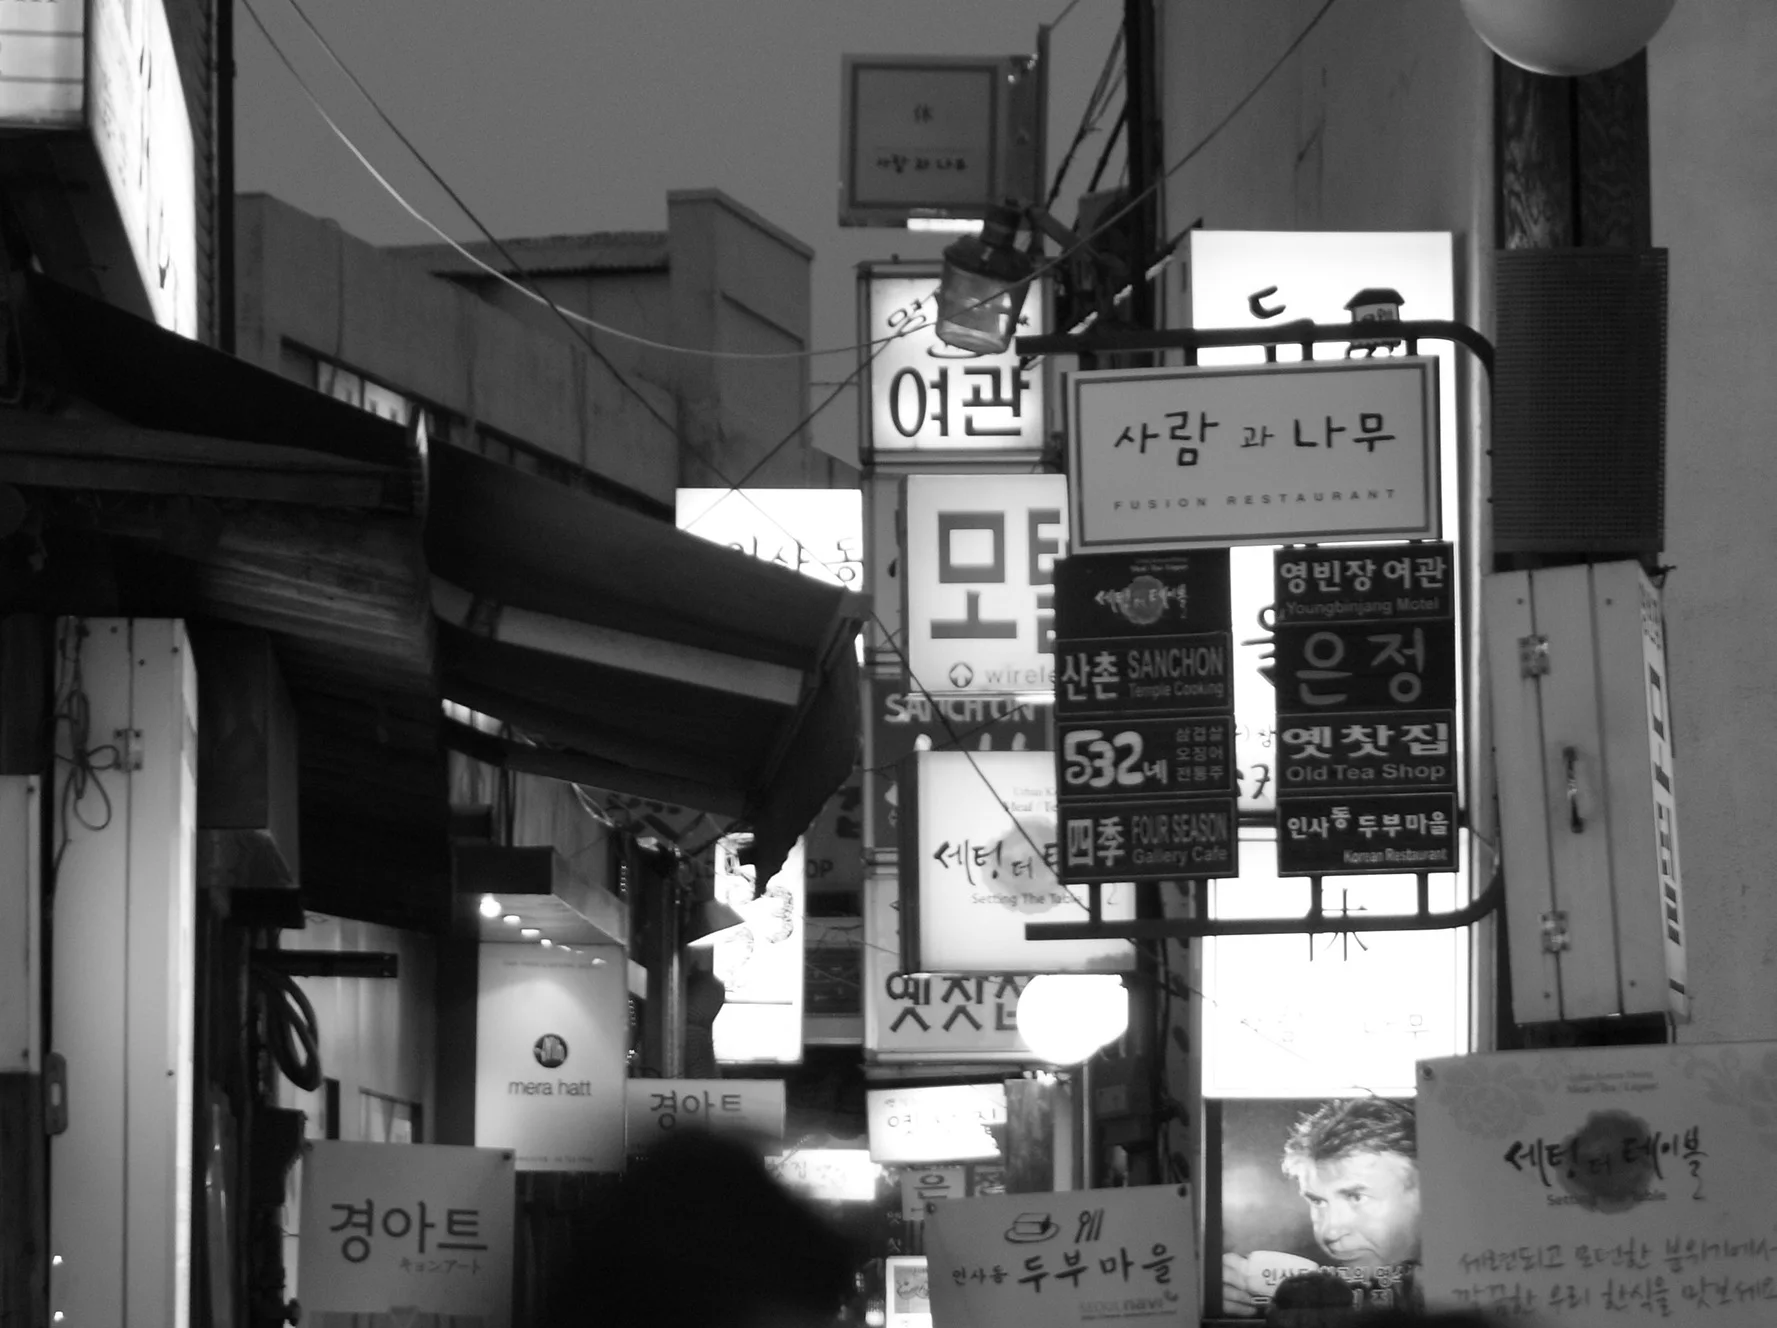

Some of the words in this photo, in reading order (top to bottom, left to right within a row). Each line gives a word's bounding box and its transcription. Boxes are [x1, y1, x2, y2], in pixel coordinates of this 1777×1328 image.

[889, 366, 1030, 437] 여관
[1114, 411, 1220, 466] 사람
[1241, 425, 1274, 448] 과
[1294, 412, 1396, 452] 나무
[1113, 498, 1207, 511] FUSION
[1226, 488, 1396, 506] RESTAURANT
[1280, 559, 1377, 593] 영빈장
[1383, 556, 1447, 590] 여관
[1397, 597, 1440, 611] Motel
[1061, 651, 1120, 701] 산촌
[1127, 646, 1225, 679] SANCHON
[1296, 627, 1426, 705] 은정
[1064, 730, 1168, 787] 532네
[1281, 722, 1449, 759] 옛찻집
[1286, 765, 1328, 781] Old
[1333, 765, 1375, 780] Tea
[1382, 763, 1446, 781] Shop
[1067, 816, 1126, 866] 四季
[1131, 814, 1170, 844] FOUR
[1172, 812, 1228, 842] SEASON
[1287, 806, 1351, 840] 인사동
[1358, 811, 1449, 839] 두부마을
[508, 1080, 553, 1096] mera
[557, 1078, 592, 1096] hatt
[650, 1090, 742, 1130] 경아트
[329, 1198, 489, 1263] 경아트
[1018, 1244, 1176, 1293] 두부마을
[1548, 1283, 1591, 1312] 우리
